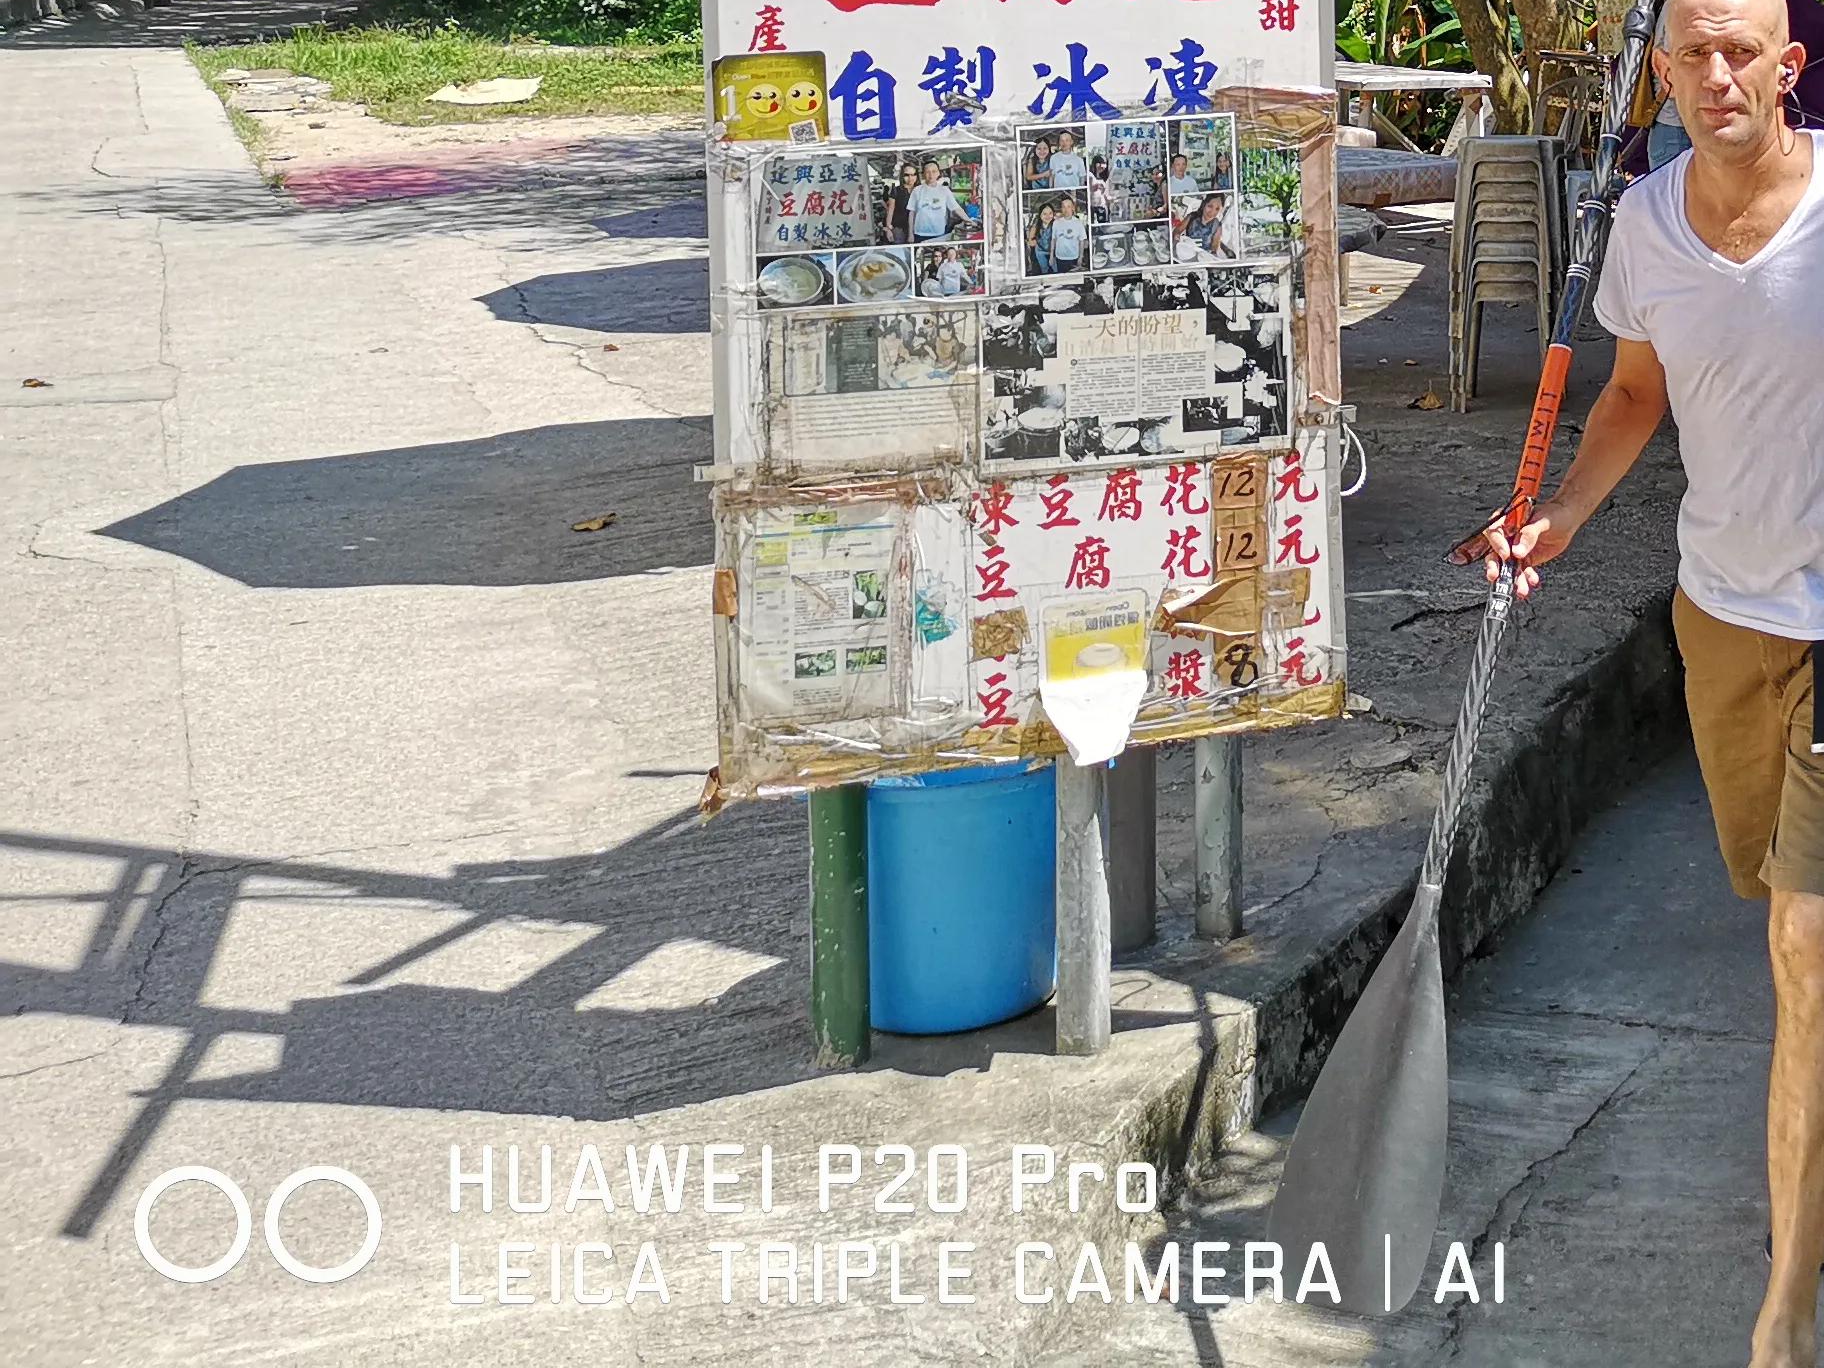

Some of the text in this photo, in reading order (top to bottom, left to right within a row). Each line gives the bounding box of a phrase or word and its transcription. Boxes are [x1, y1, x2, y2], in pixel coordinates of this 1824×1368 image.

[776, 188, 854, 219] 豆腐花
[1219, 470, 1256, 500] 12
[1273, 449, 1319, 503] 元
[1222, 532, 1258, 564] 12
[1276, 514, 1321, 566] 元
[1279, 636, 1322, 687] 元
